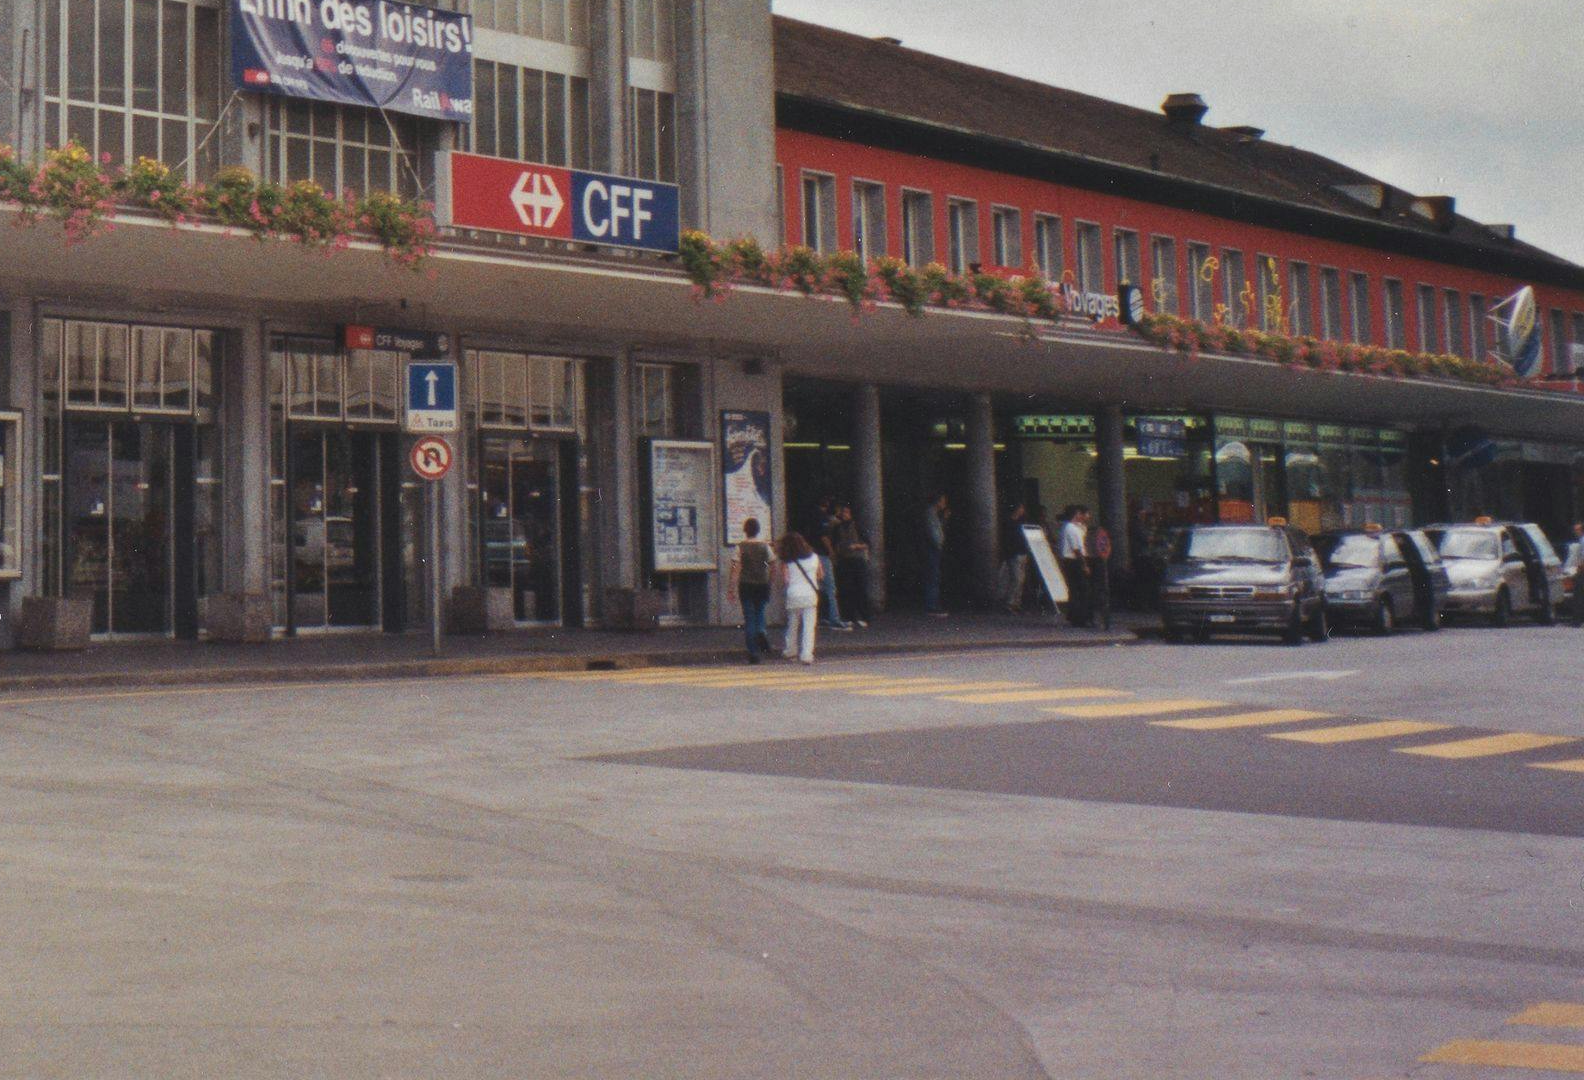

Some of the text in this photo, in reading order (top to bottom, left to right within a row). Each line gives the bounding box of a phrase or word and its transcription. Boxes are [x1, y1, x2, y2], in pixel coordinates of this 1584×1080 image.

[378, 0, 472, 53] loisirs!
[337, 60, 353, 75] de
[583, 180, 653, 240] CFF
[376, 334, 392, 346] CFF
[427, 417, 454, 428] Taxis
